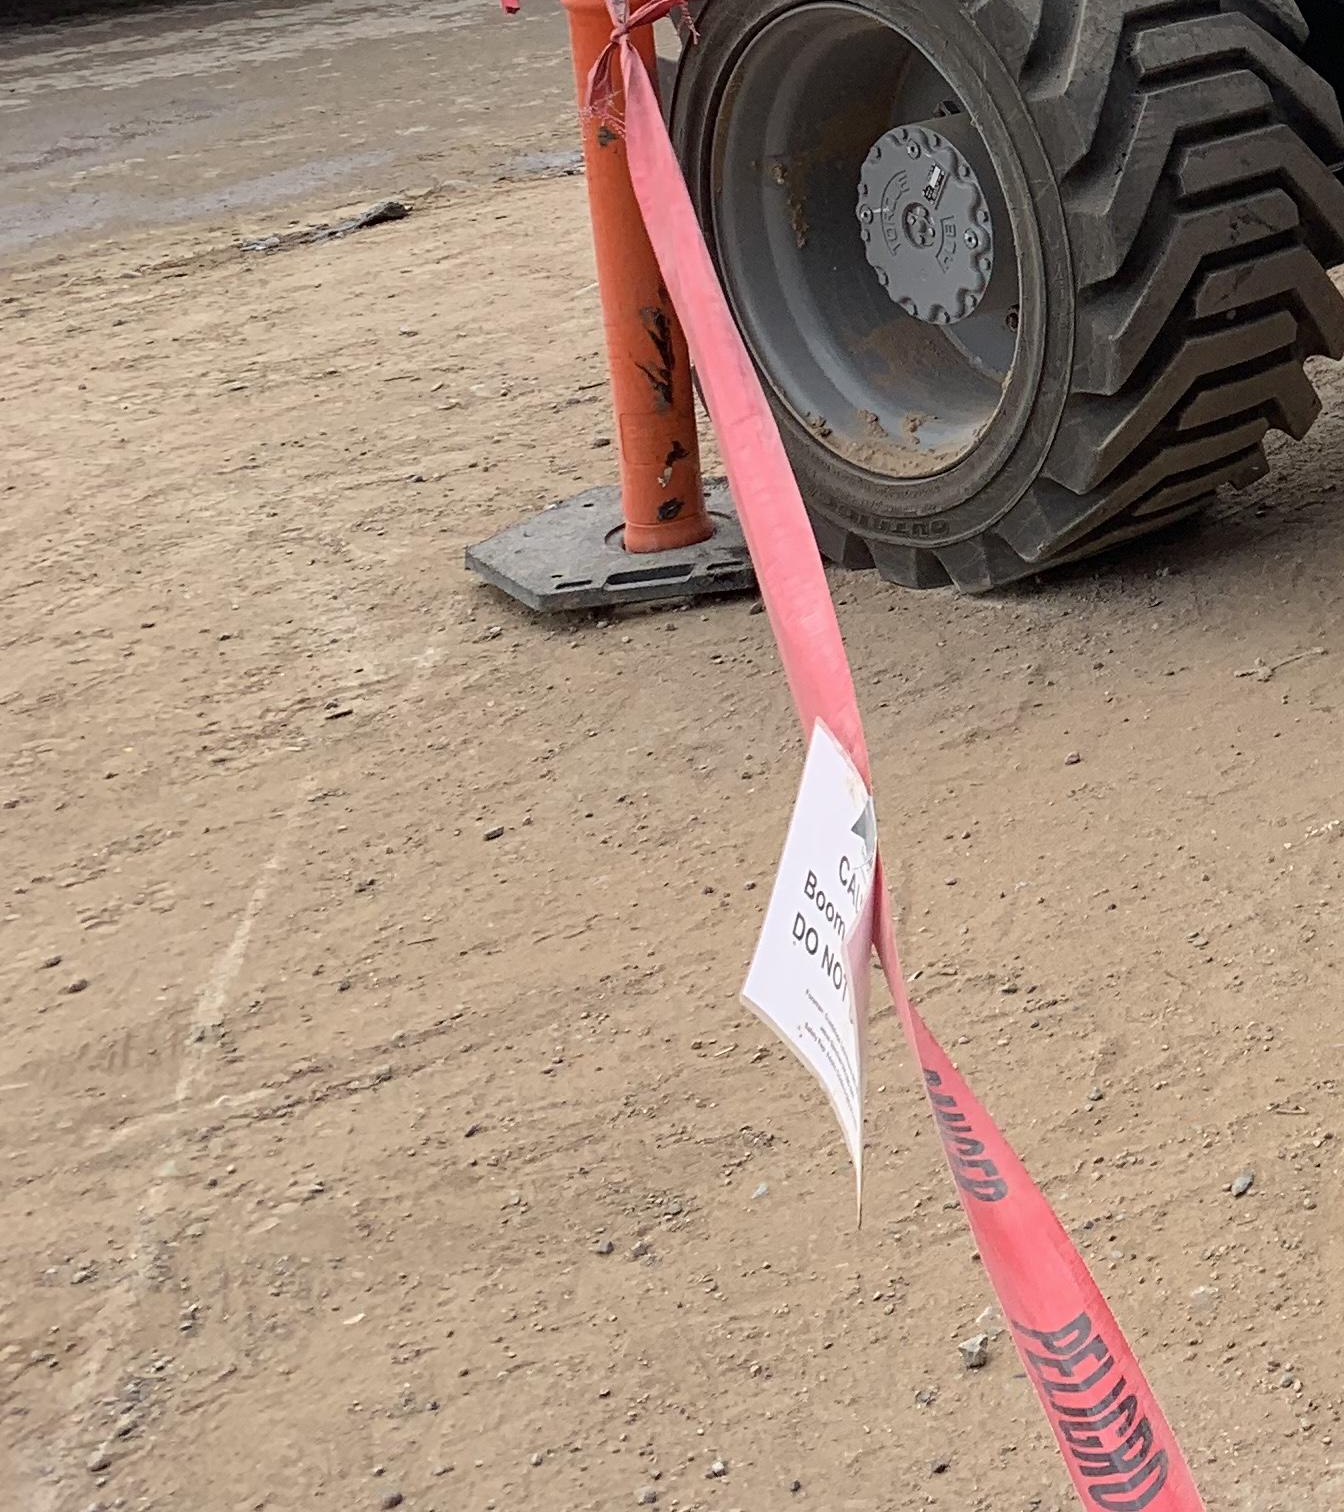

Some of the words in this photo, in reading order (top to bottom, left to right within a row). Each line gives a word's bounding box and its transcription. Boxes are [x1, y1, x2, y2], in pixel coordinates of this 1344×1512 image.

[791, 911, 819, 956] DO
[803, 869, 846, 941] Boom
[1012, 1310, 1169, 1512] PELIGRO
